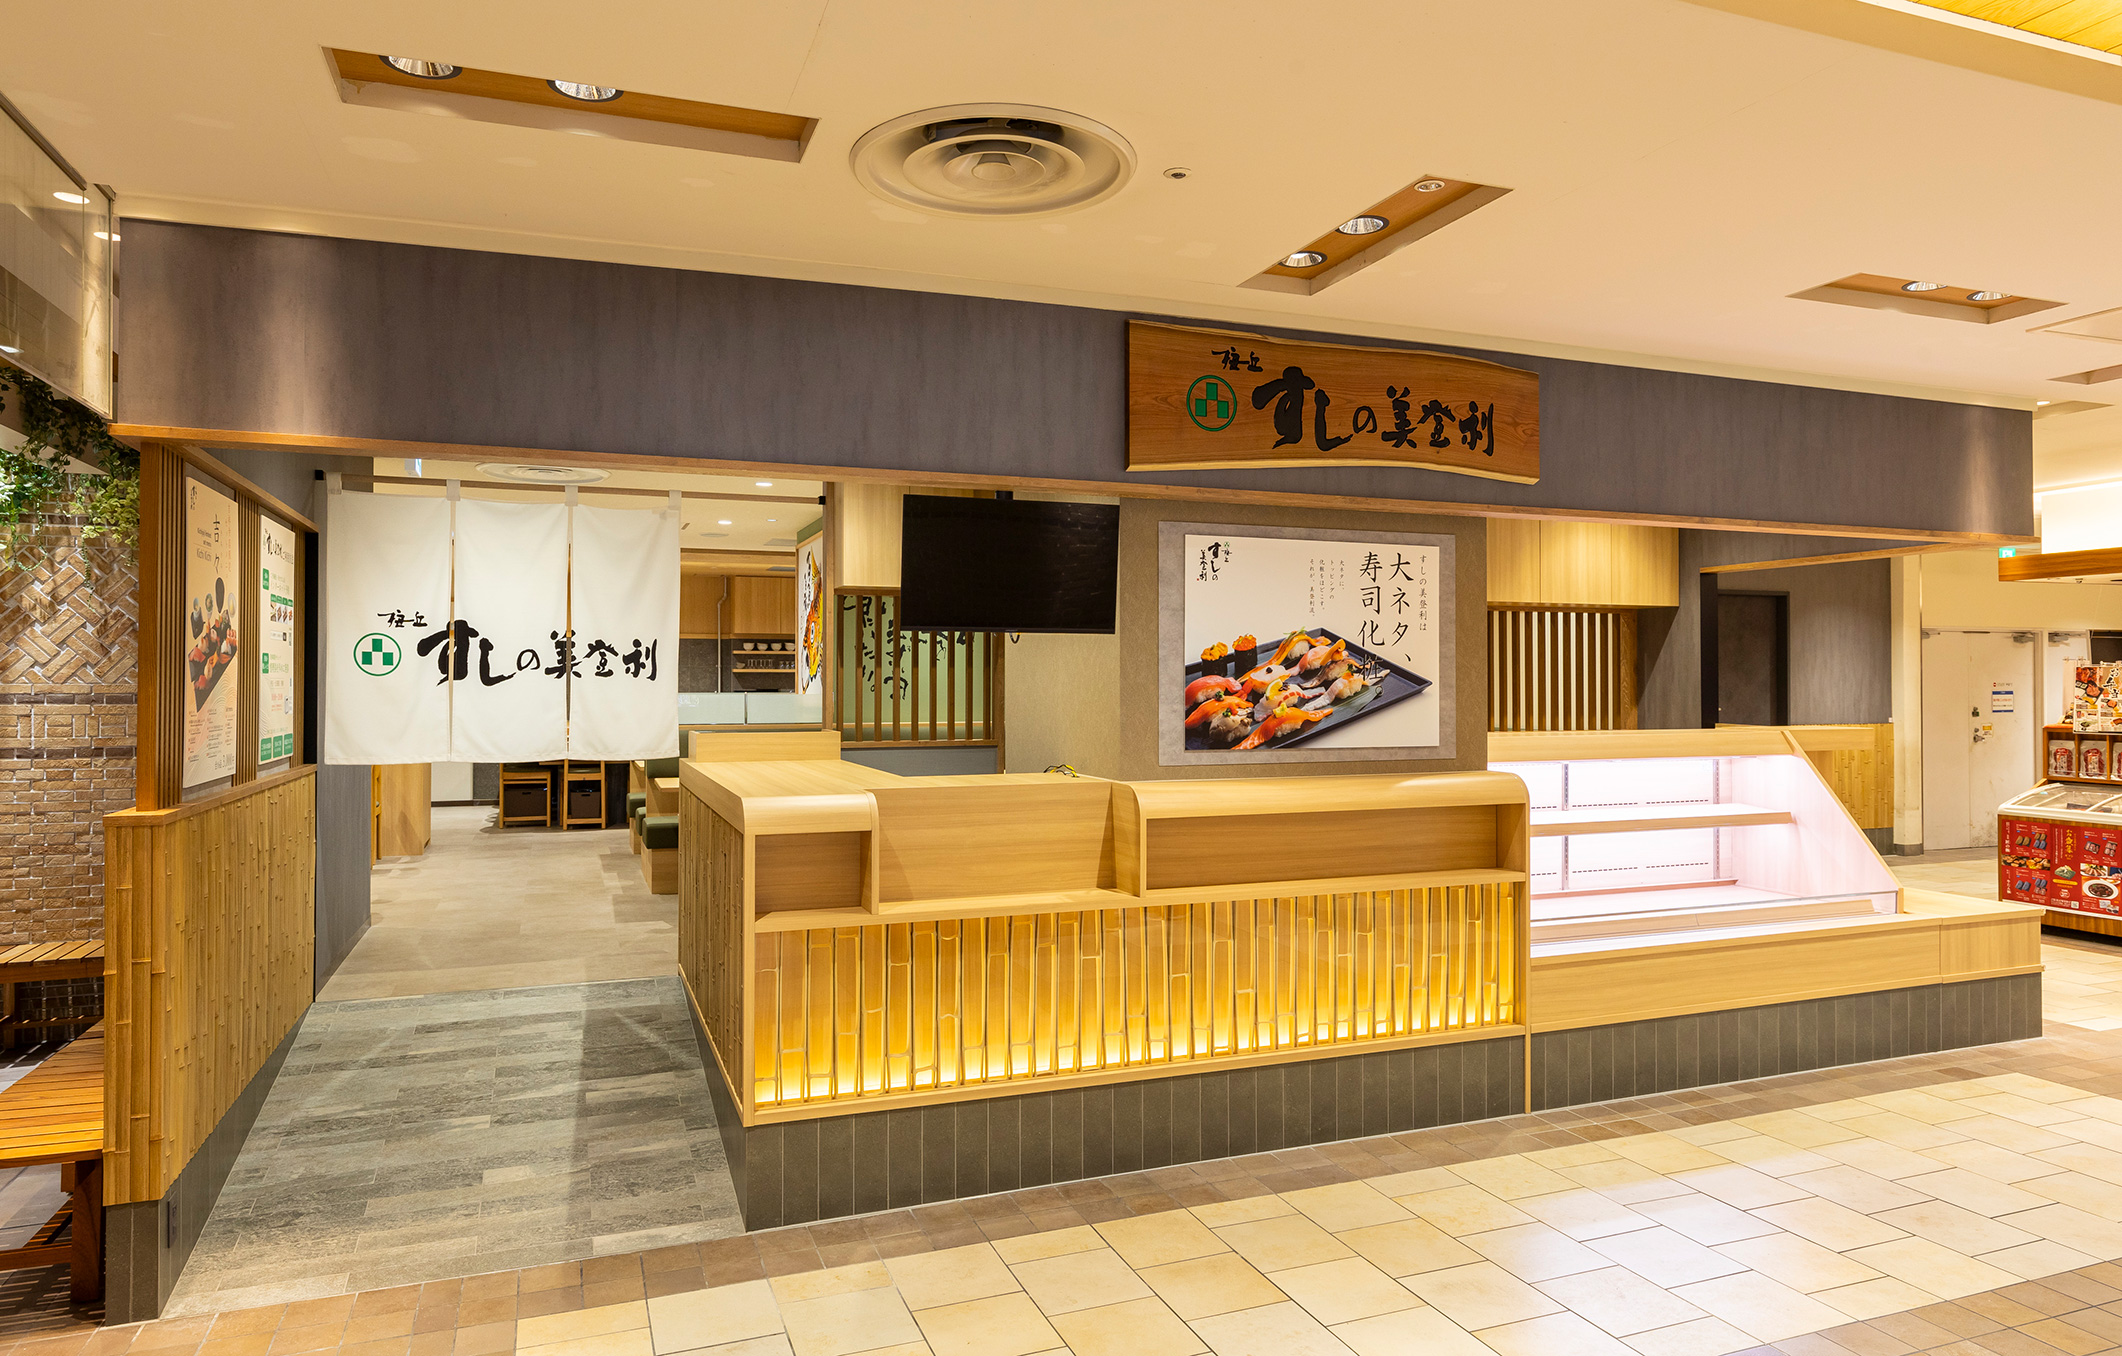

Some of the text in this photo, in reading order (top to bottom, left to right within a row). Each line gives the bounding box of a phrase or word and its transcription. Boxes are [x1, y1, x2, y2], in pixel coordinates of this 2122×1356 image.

[1251, 366, 1494, 457] すしの美登利
[1357, 551, 1385, 695] 寿司化粧。
[1388, 552, 1414, 662] 大ネタ、
[1418, 554, 1428, 631] すしの美登利は
[416, 619, 658, 687] すしの美登利
